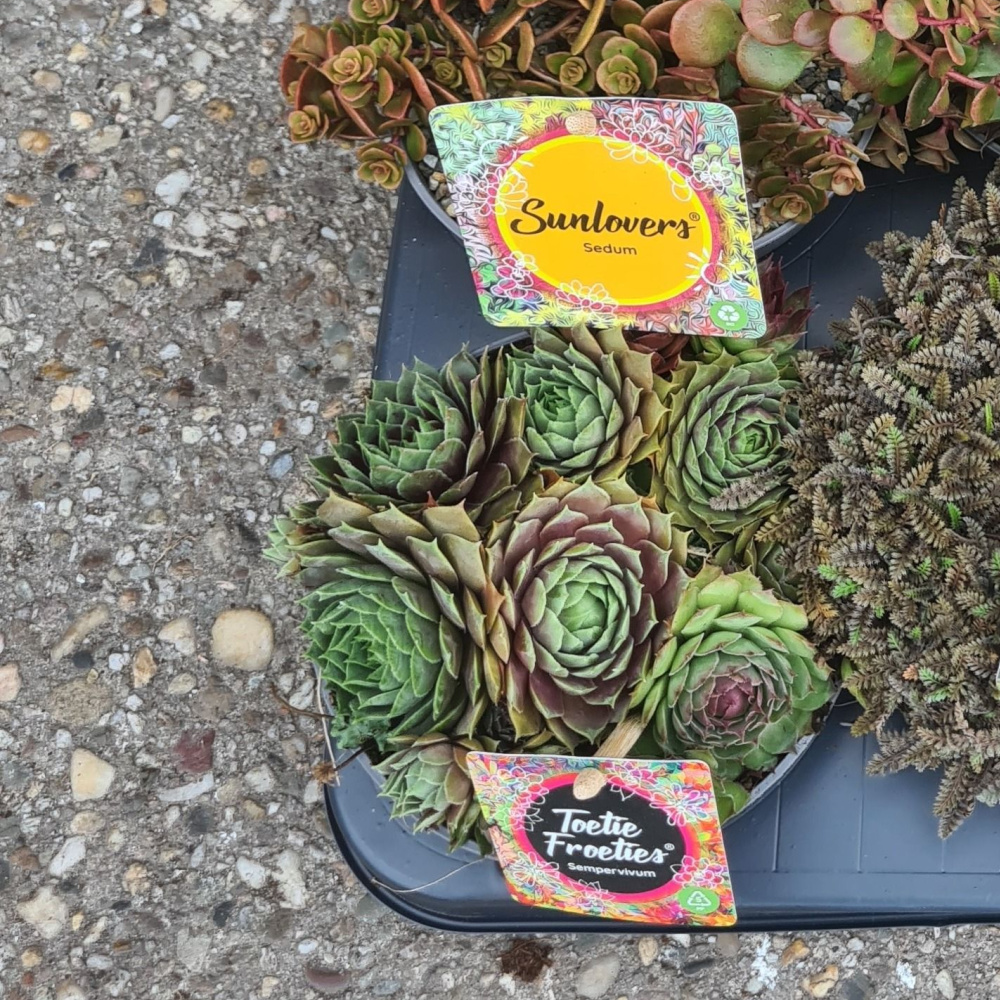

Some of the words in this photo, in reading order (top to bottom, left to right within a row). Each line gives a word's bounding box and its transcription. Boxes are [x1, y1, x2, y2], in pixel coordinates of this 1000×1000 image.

[510, 198, 697, 239] Sunlovers
[583, 242, 637, 255] Sedum
[551, 808, 643, 838] Toetie
[542, 831, 670, 865] Froeties
[567, 862, 657, 878] Sempervivum
